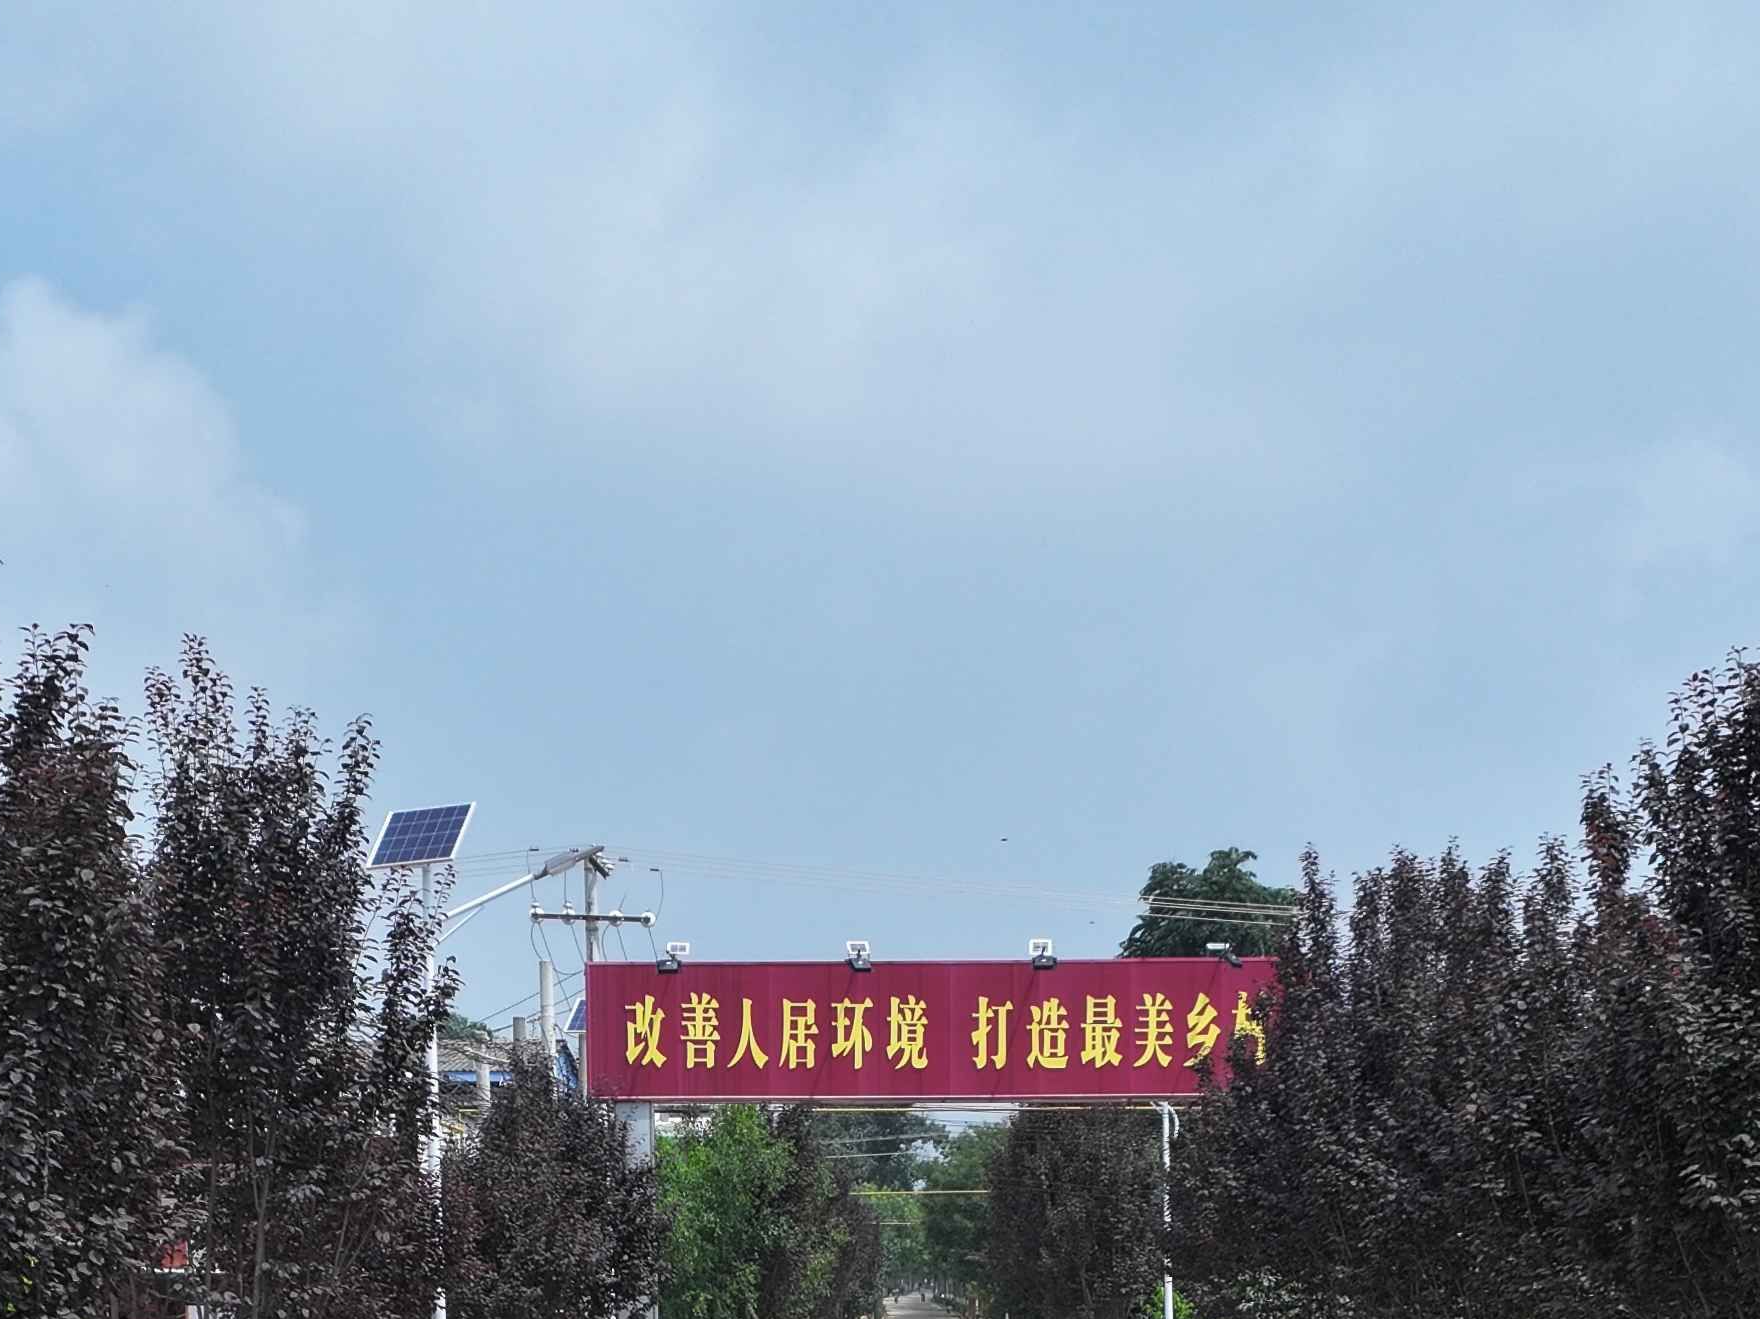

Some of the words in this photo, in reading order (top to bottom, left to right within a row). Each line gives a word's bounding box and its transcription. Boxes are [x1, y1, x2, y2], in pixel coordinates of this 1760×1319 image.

[625, 992, 930, 1070] 改善人居环境
